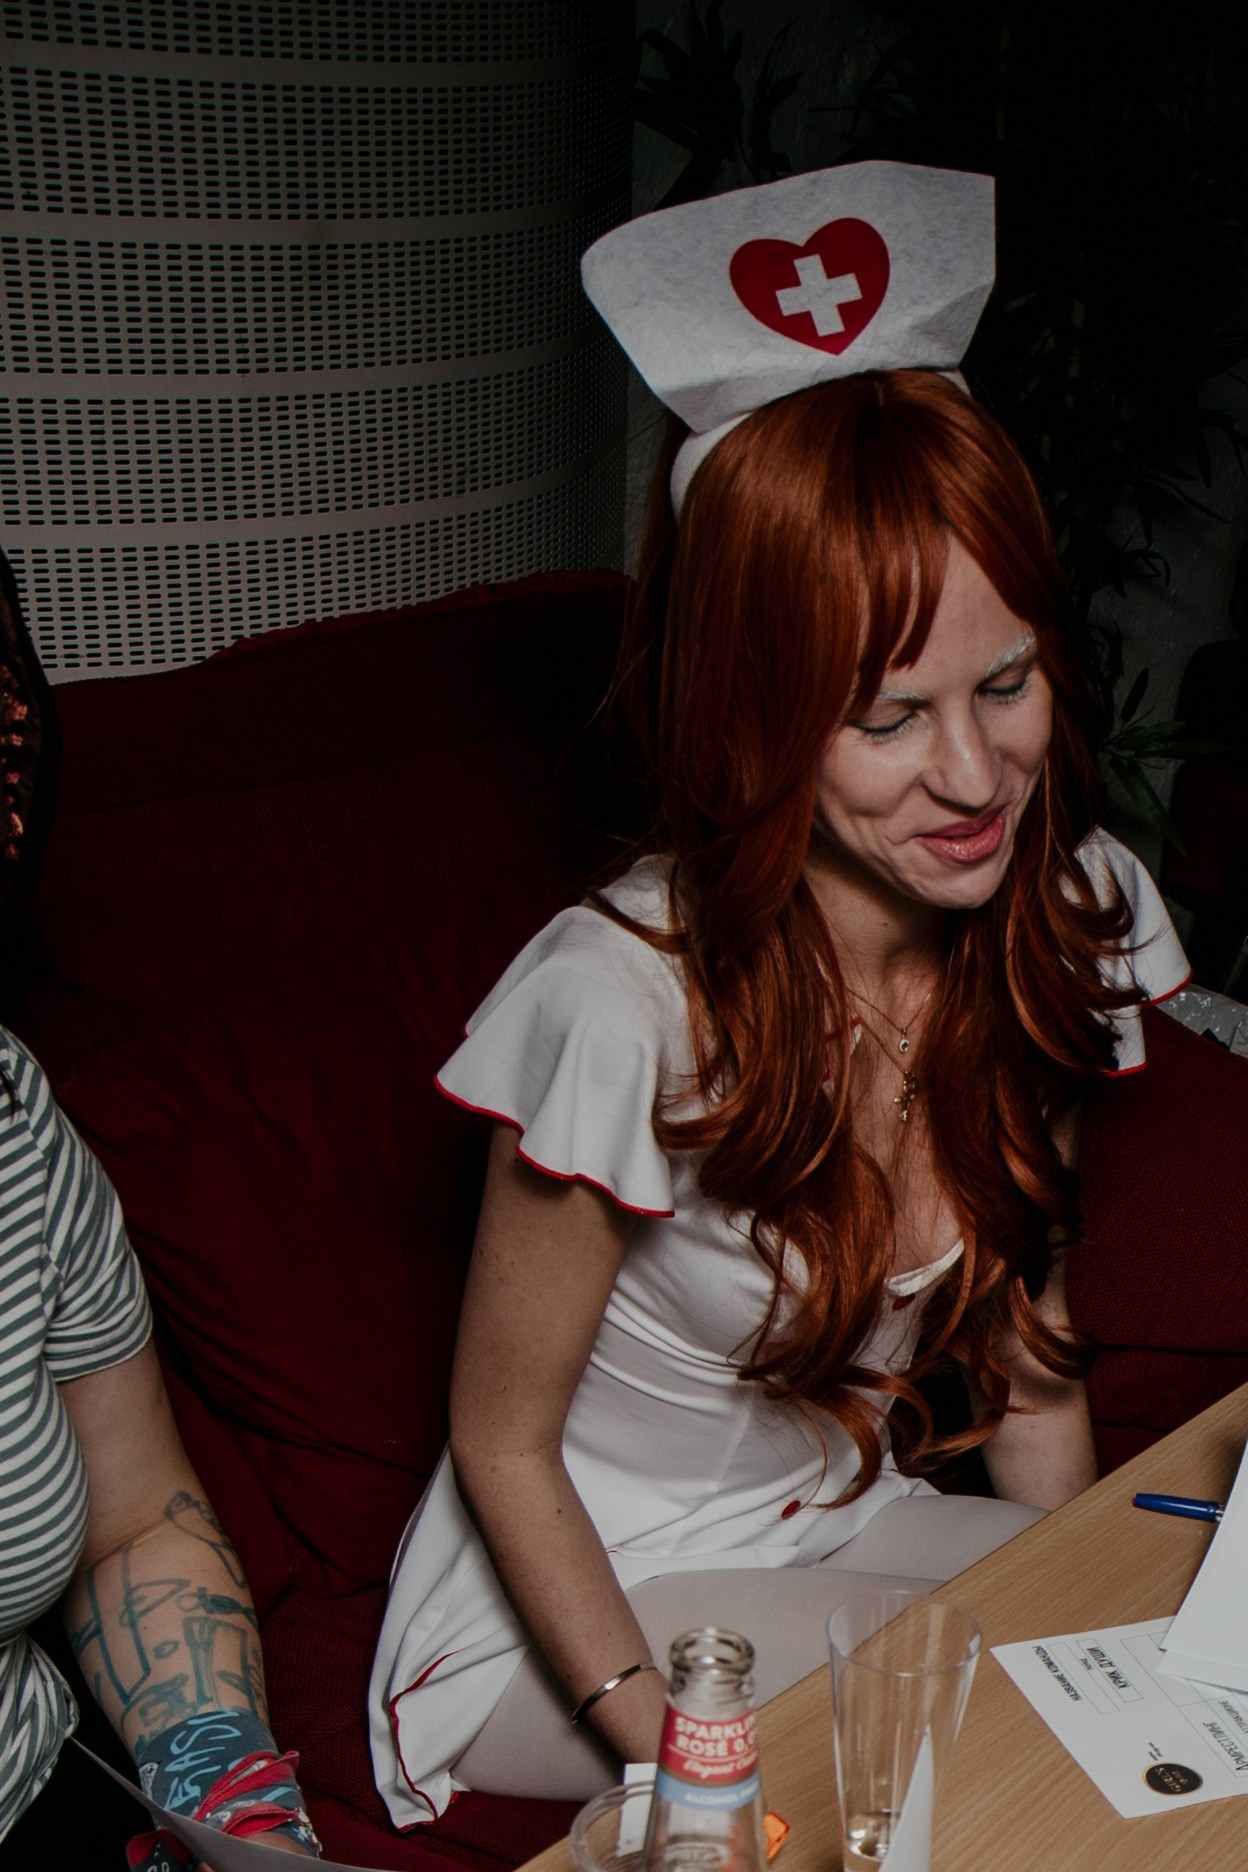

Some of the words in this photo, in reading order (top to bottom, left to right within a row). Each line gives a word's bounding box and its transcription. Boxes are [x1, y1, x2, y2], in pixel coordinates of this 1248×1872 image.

[1032, 1645, 1060, 1675] КОМАНДЫ
[1086, 1646, 1116, 1668] ДУШИ
[1053, 1673, 1083, 1702] НАЗВАНИЕ
[1104, 1670, 1131, 1689] КРИК
